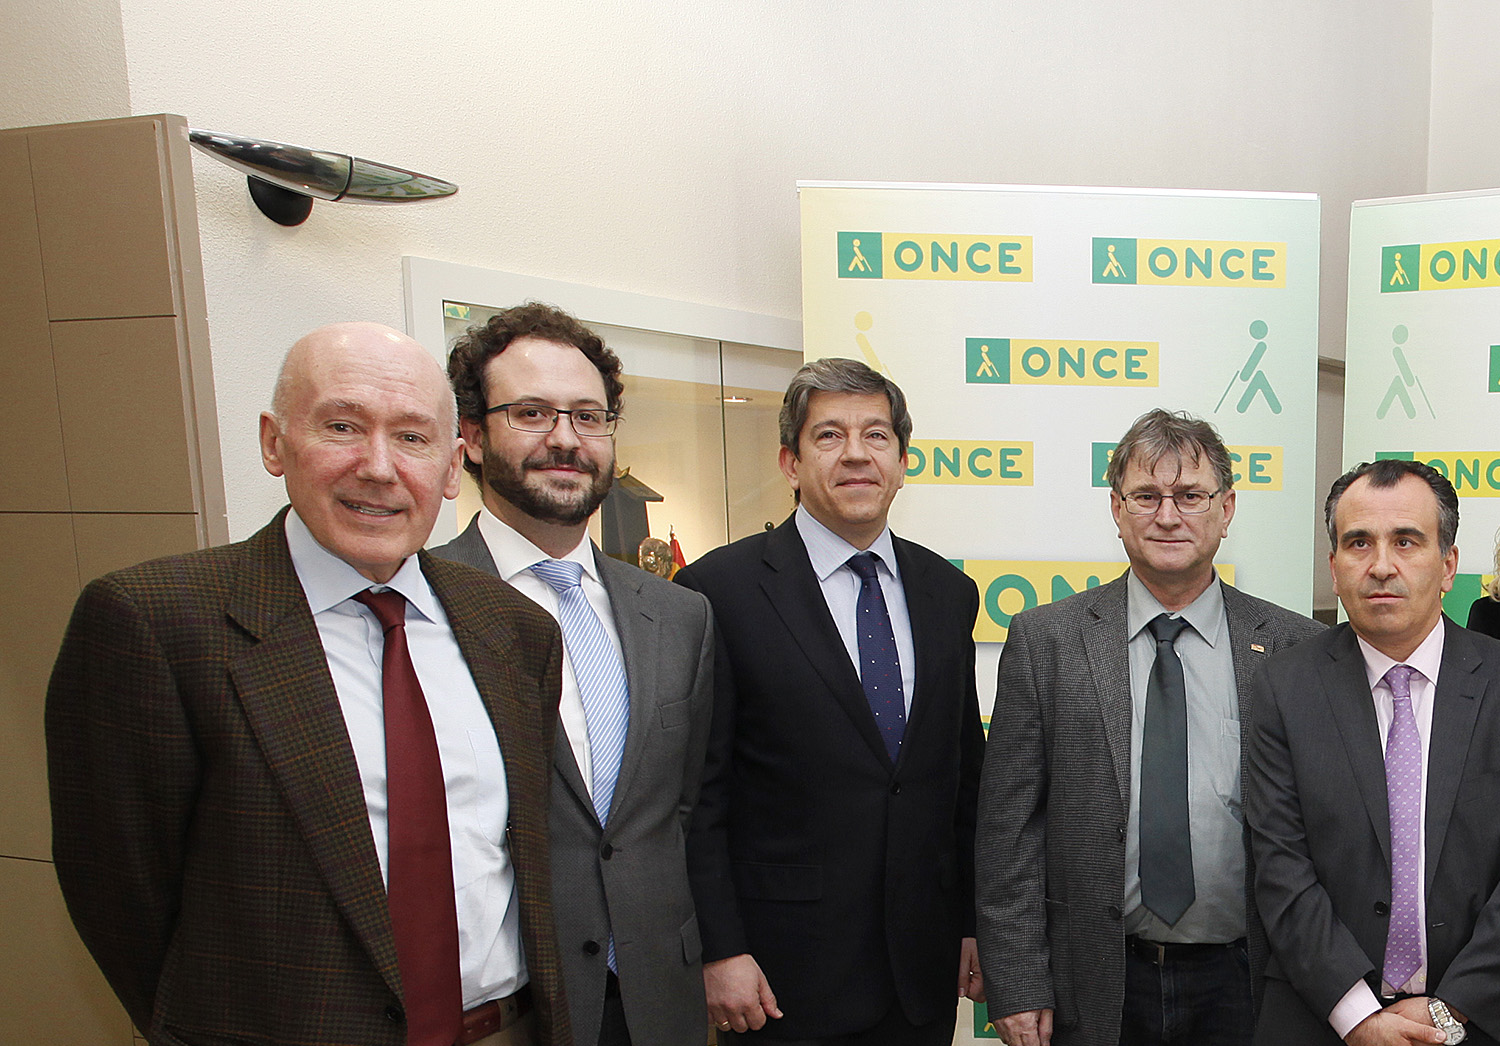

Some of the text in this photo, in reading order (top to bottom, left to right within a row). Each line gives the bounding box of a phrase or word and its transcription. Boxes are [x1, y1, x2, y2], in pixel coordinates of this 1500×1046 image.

[894, 241, 1021, 274] ONCE
[1149, 247, 1275, 280] ONCE
[1022, 347, 1148, 379] ONCE
[905, 446, 1023, 478] ONCE
